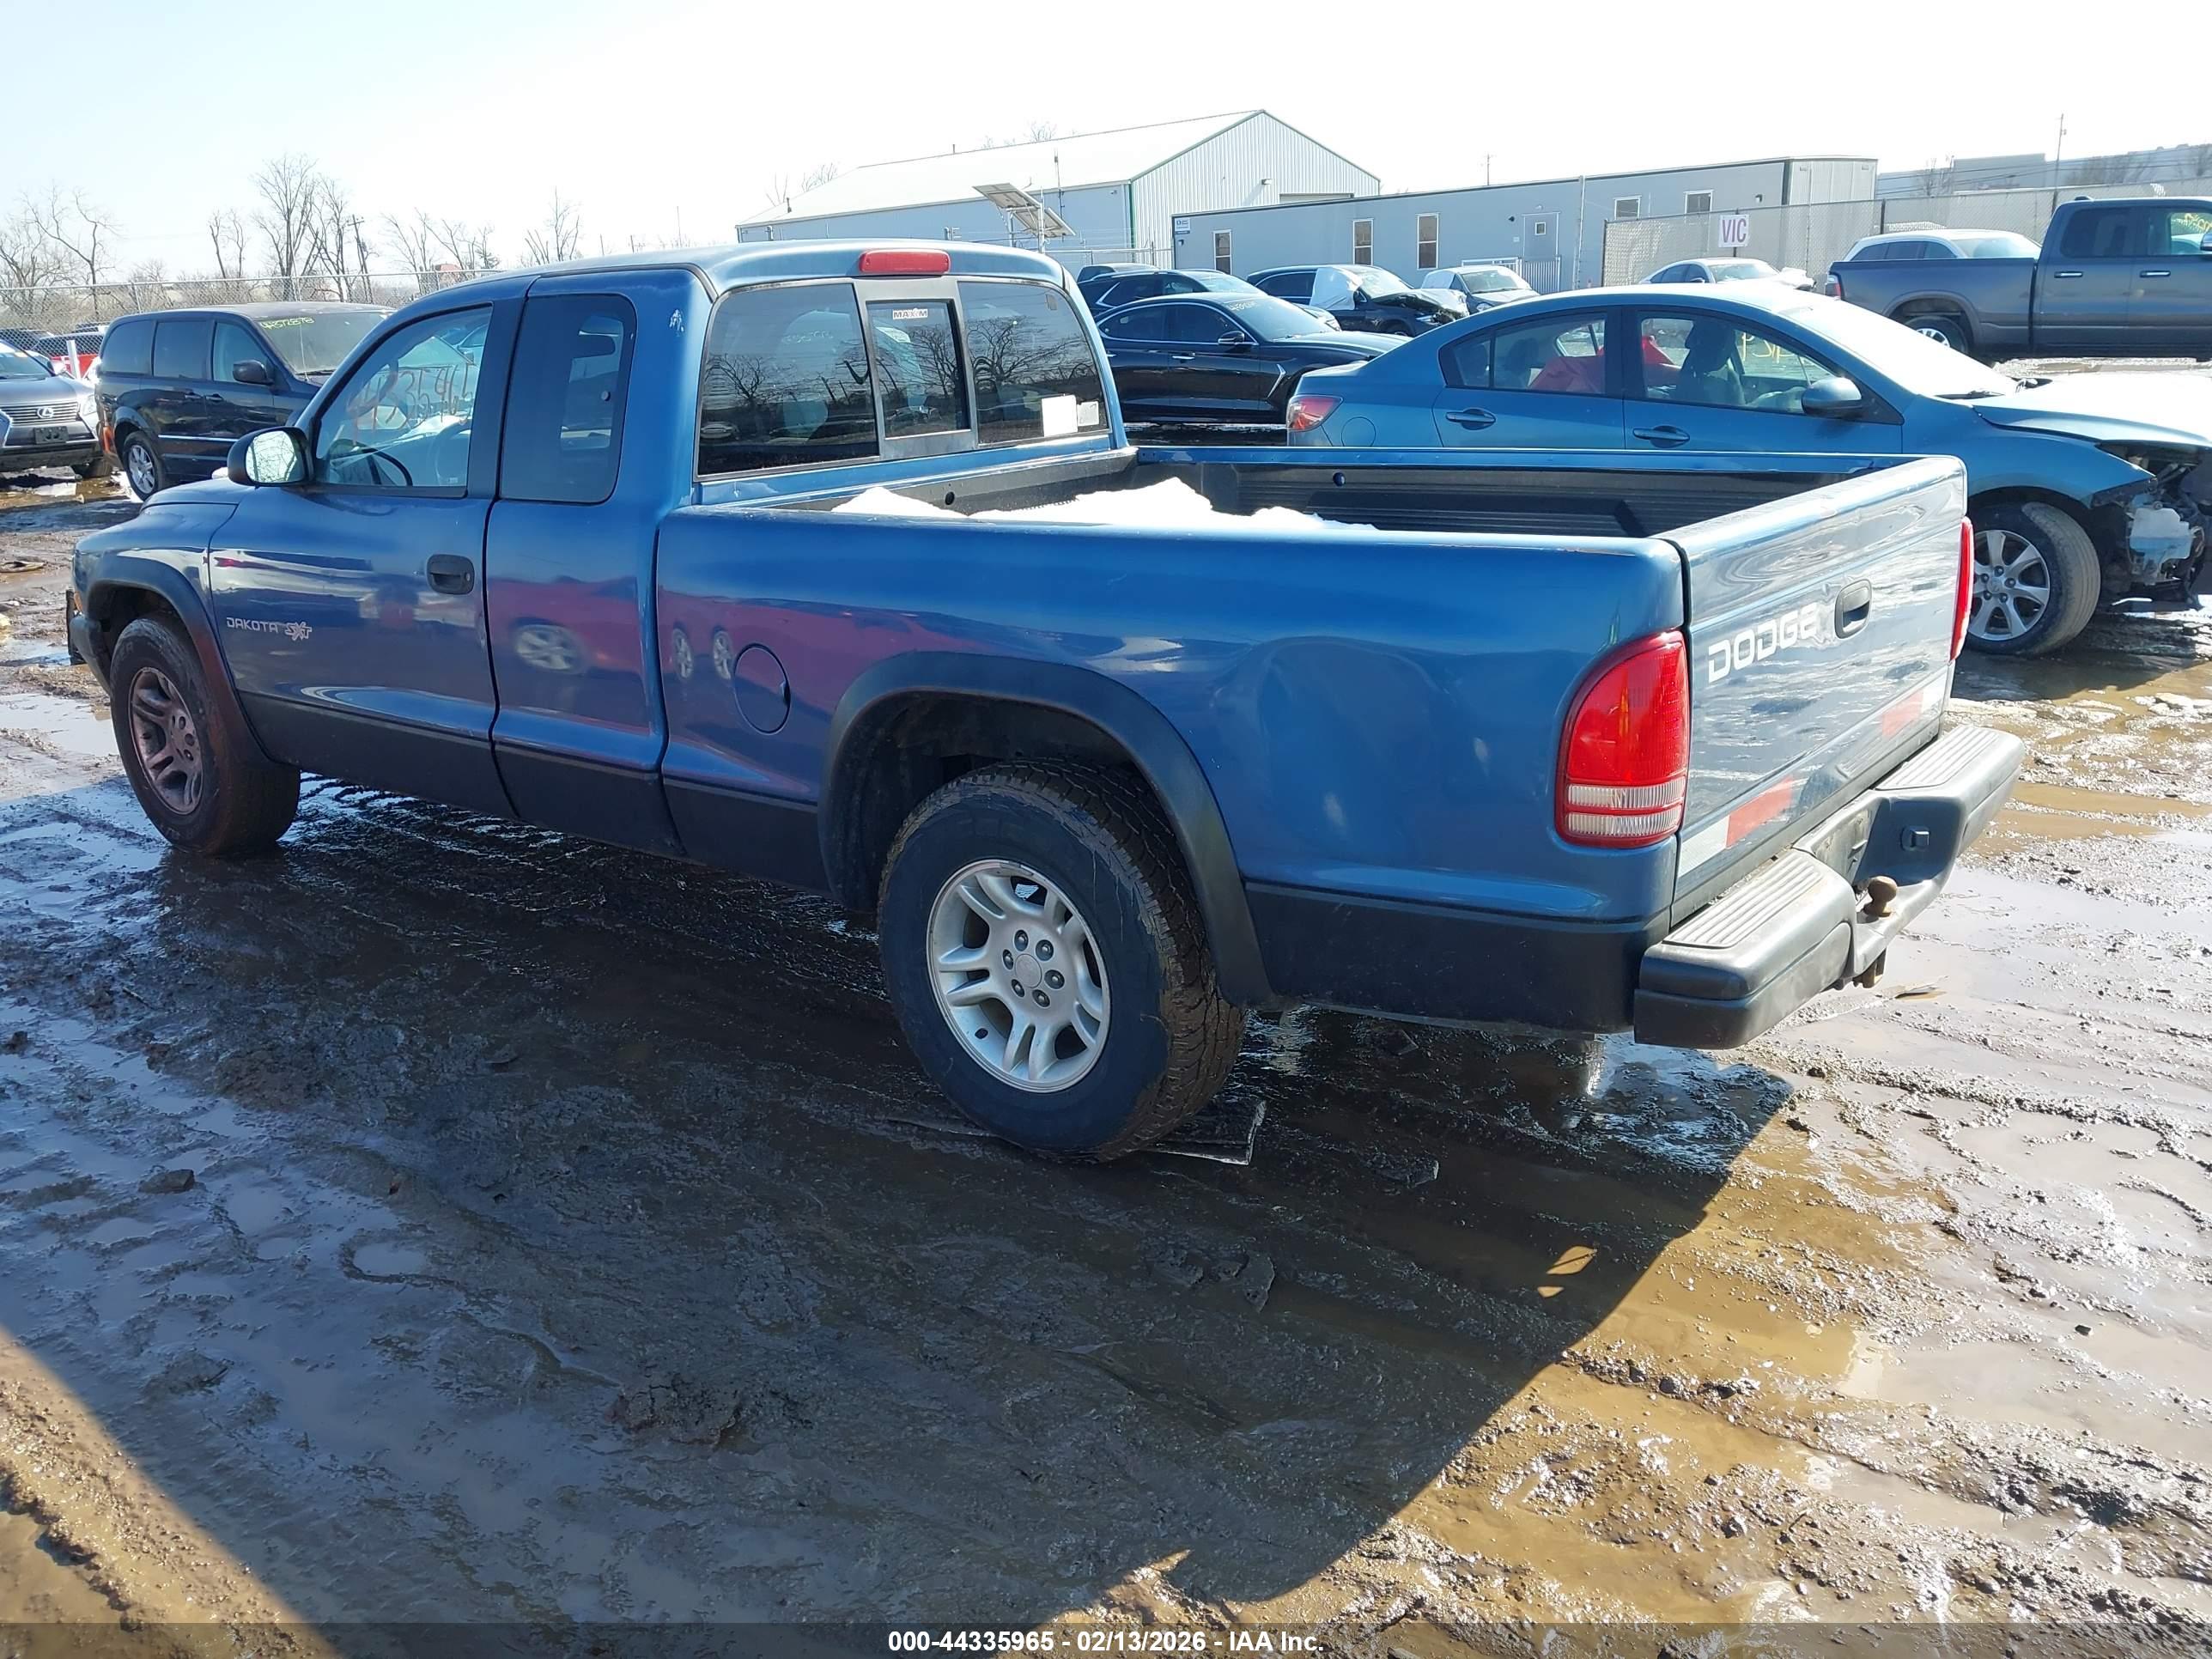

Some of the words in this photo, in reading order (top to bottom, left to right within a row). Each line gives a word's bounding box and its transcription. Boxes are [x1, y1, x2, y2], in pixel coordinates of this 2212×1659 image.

[1723, 218, 1747, 243] VIC
[226, 617, 279, 634] DAKOTA
[284, 621, 313, 641] SXT
[1708, 602, 1818, 684] DODGE
